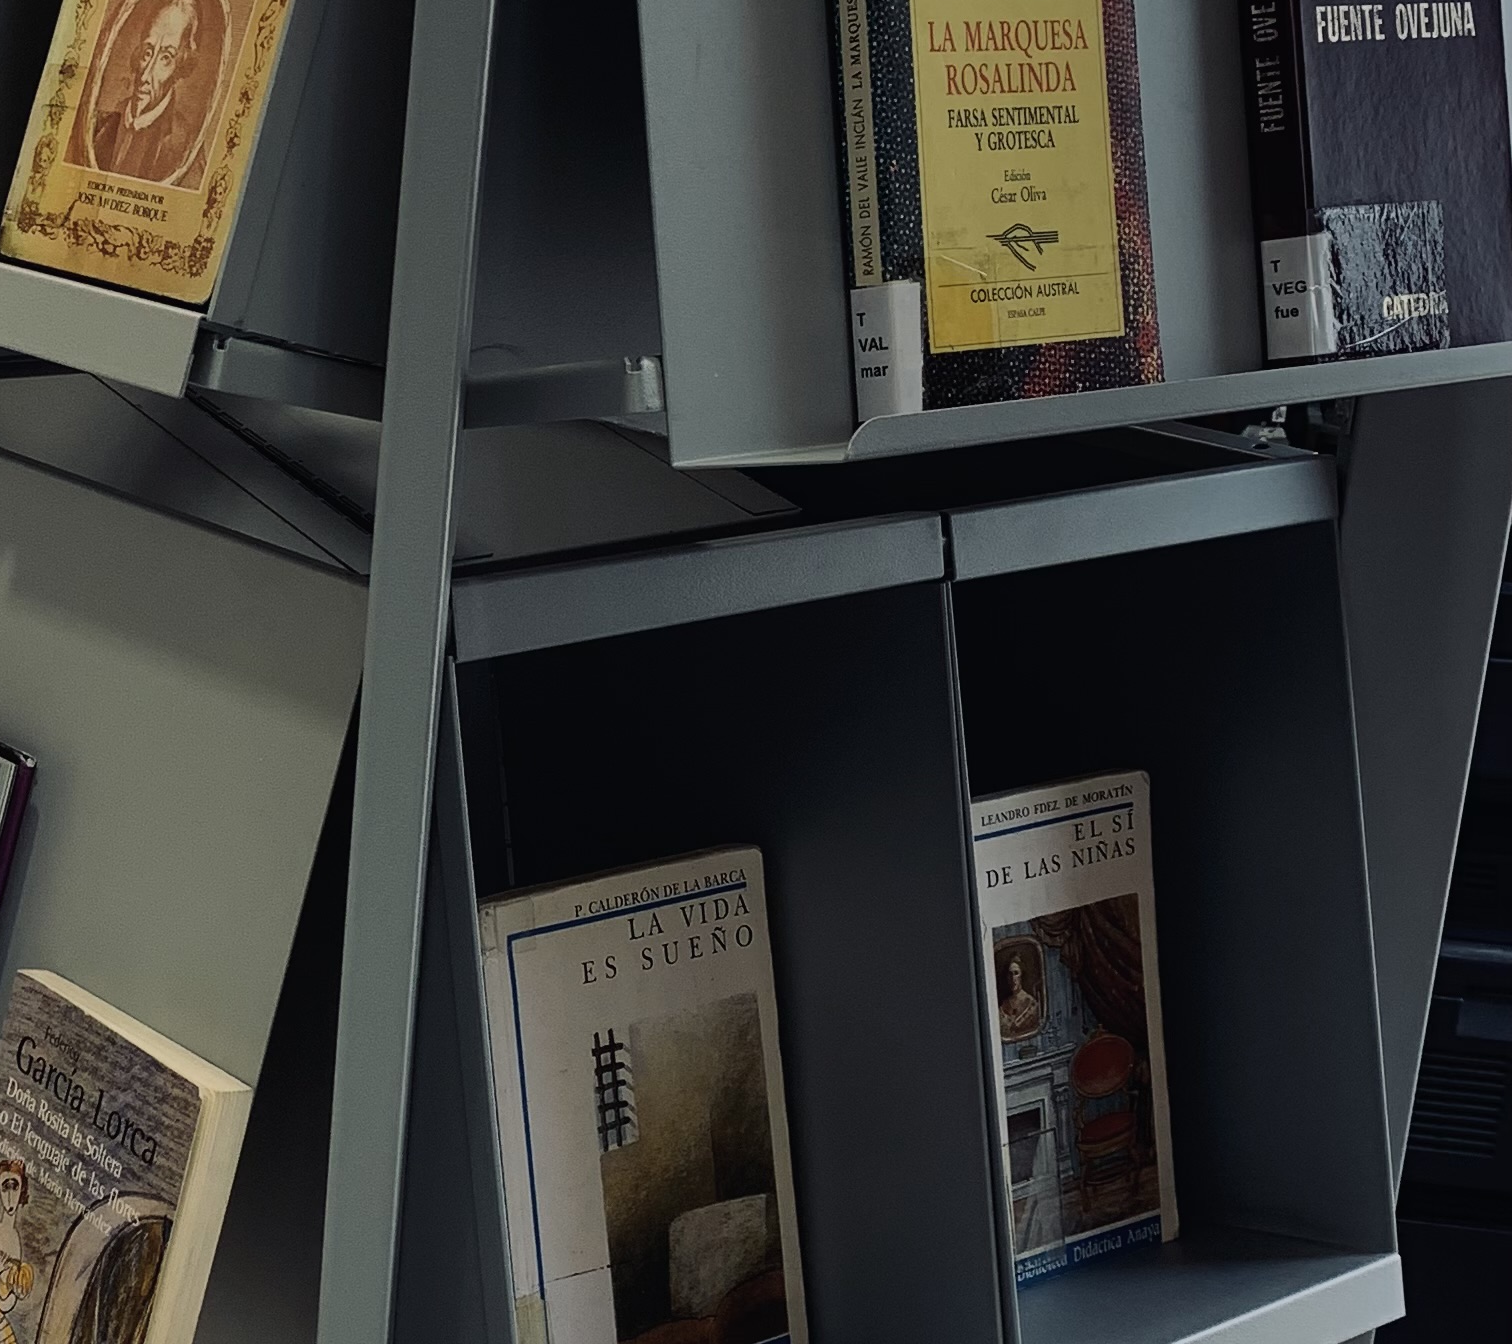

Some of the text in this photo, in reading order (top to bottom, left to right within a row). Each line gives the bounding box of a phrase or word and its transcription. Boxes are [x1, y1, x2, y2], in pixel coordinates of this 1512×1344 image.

[1315, 1, 1476, 43] FUENTE OVEJUNA
[927, 19, 1089, 58] LA MARQUESA
[851, 69, 863, 90] LA
[945, 61, 1077, 96] ROSALINDA
[852, 98, 868, 153] INCLÁN
[948, 105, 1080, 129] FARSA SENTIMENTAL
[976, 129, 1056, 151] Y GROTESCA
[855, 155, 869, 193] VALLE
[1004, 169, 1031, 183] Edición
[151, 194, 165, 205] POR
[858, 197, 870, 219] DEL
[991, 186, 1047, 204] César Oliva
[133, 204, 168, 222] BORQUE
[859, 225, 875, 277] RAMÓN
[1270, 260, 1280, 273] T
[970, 281, 1080, 304] COLECCIÓN AUSTRAL
[1272, 281, 1307, 296] VEG
[856, 312, 866, 327] T
[1274, 306, 1299, 319] fue
[858, 337, 888, 353] VAL
[860, 365, 889, 379] mar
[981, 783, 1134, 827] LEANDRO DE MORATÍN
[1074, 808, 1135, 842] EL SÍ
[985, 837, 1137, 889] DE LAS NIÑAS
[588, 868, 747, 914] CALDERÓN DE LA BARCA
[627, 893, 751, 941] LA VIDA
[581, 924, 754, 985] ES SUEÑO
[16, 1035, 158, 1166] García Lorca
[6, 1076, 123, 1179] Doña Rosita la Soltera
[10, 1113, 141, 1227] El lenguaje de las flores
[39, 1167, 63, 1199] Mario
[1072, 1236, 1122, 1262] Didáctica
